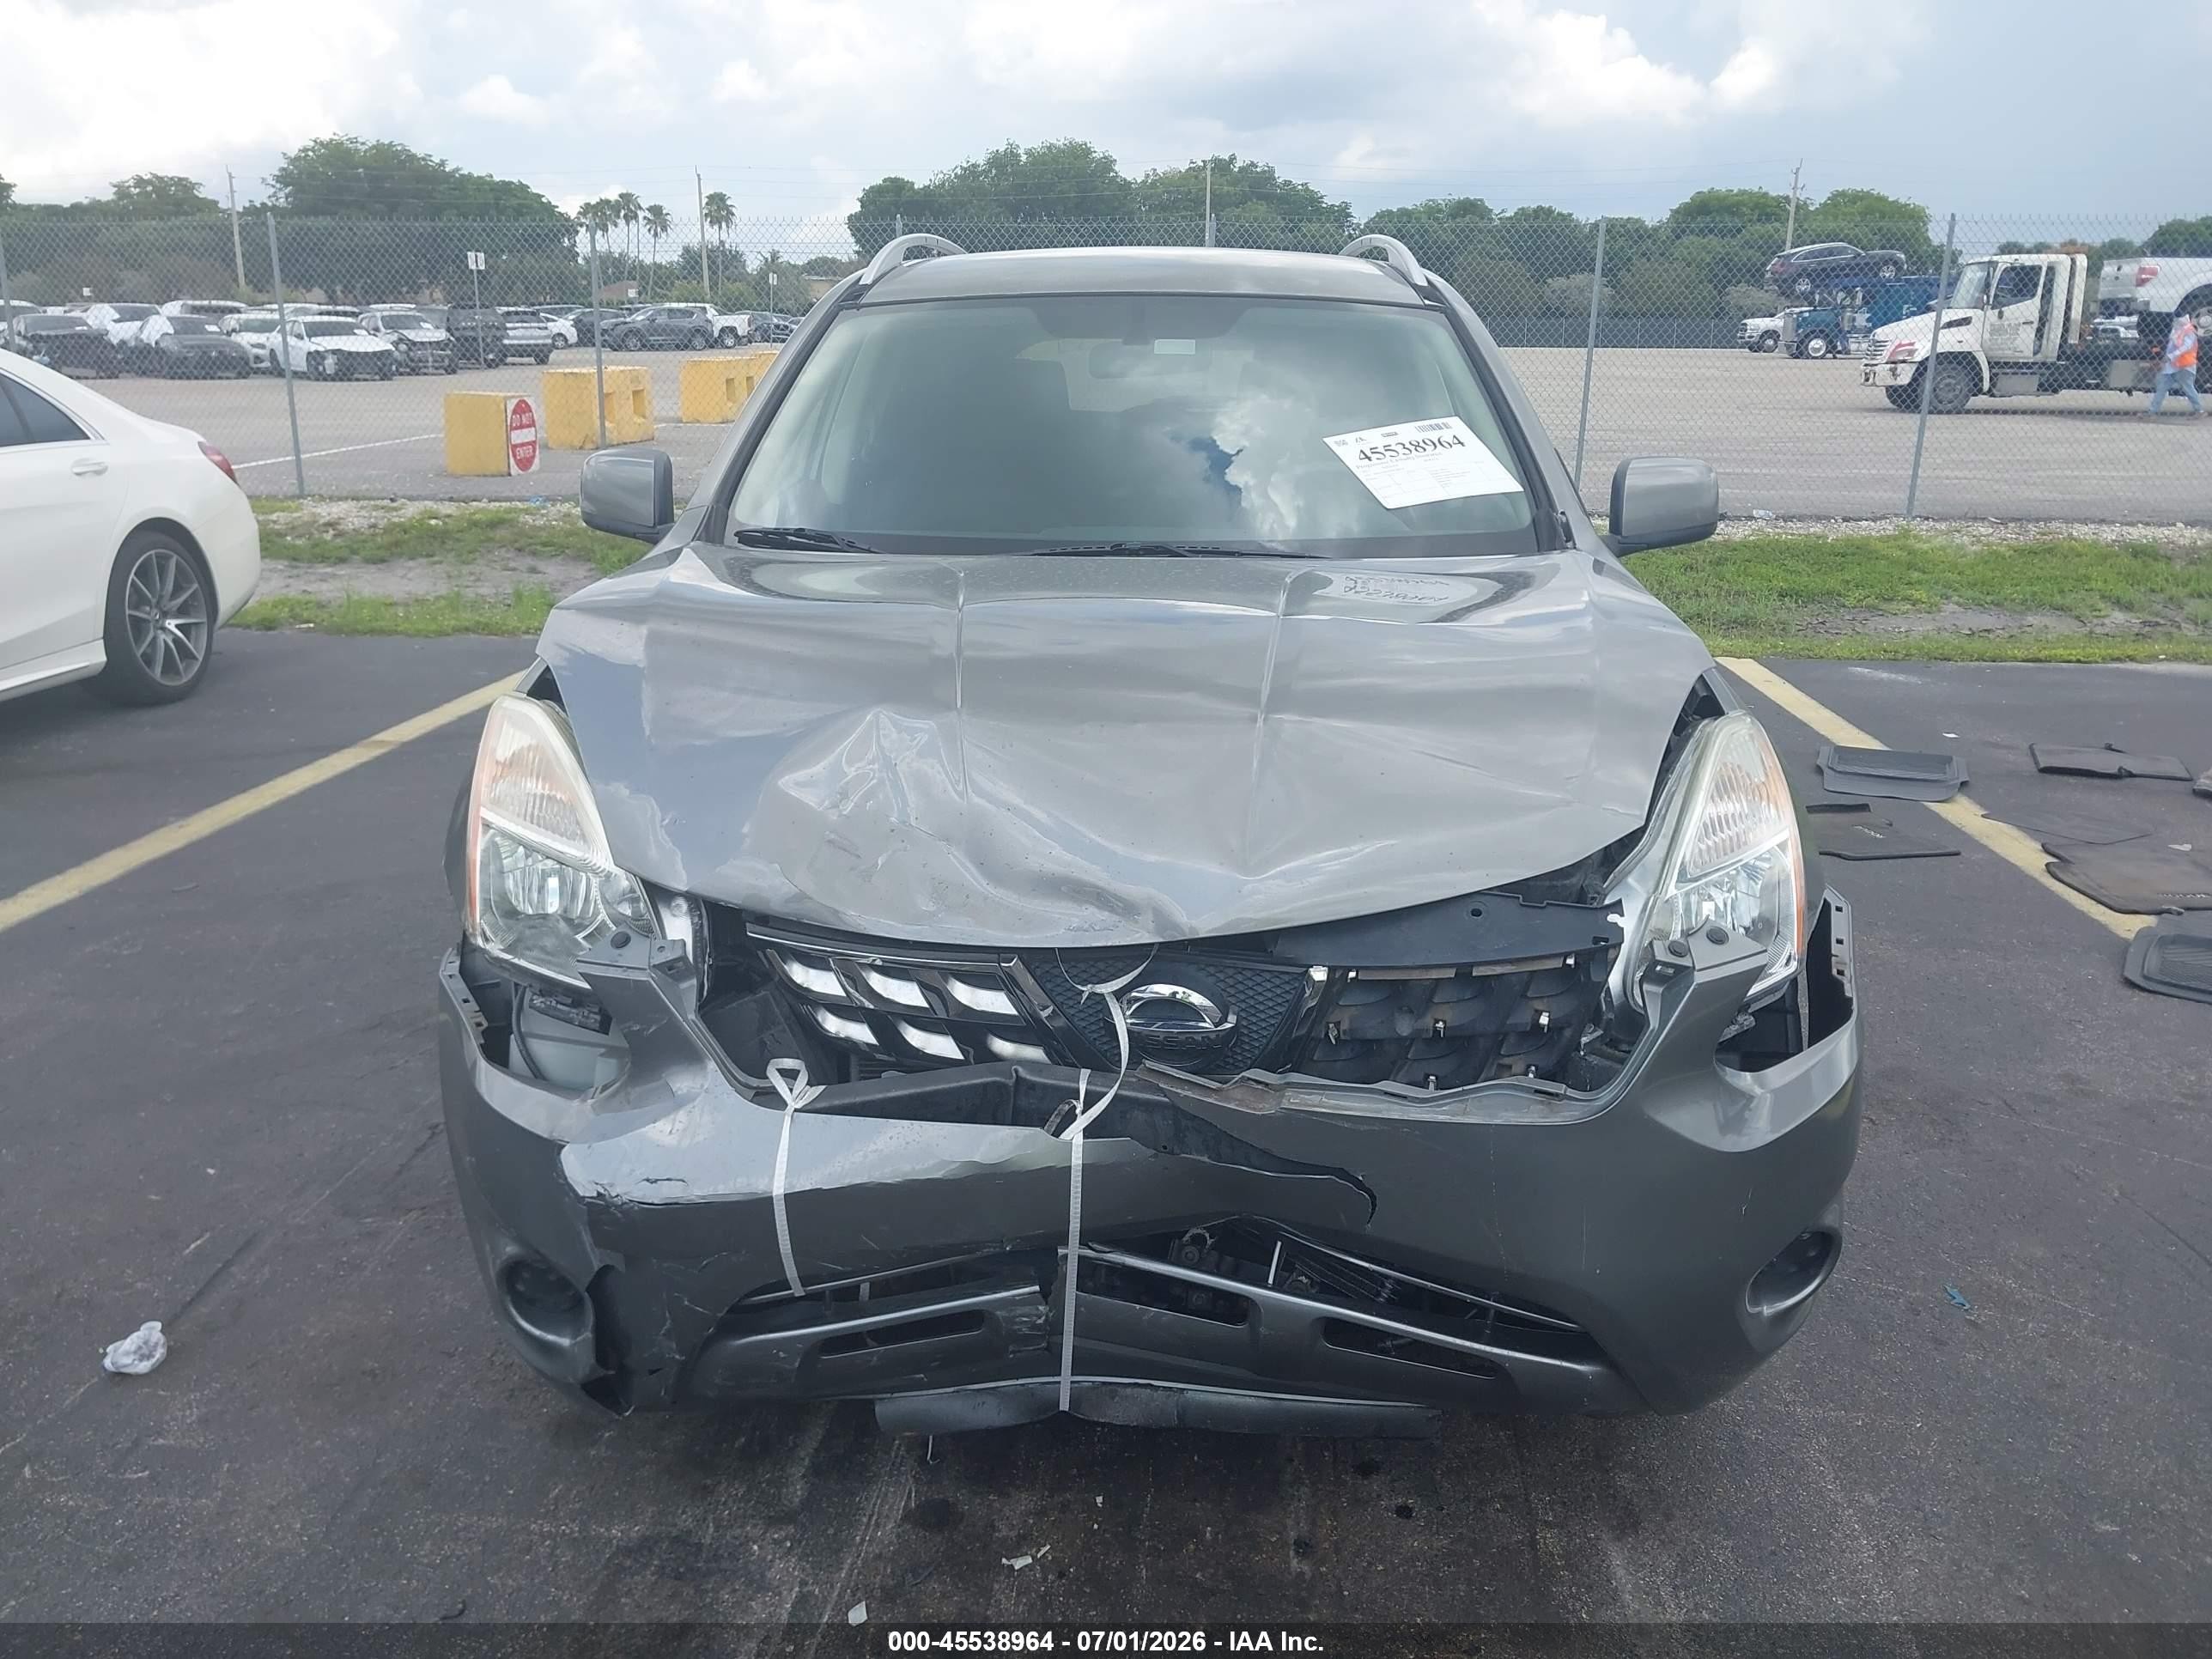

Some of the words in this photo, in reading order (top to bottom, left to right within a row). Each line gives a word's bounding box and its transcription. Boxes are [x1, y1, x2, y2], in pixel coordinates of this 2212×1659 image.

[512, 414, 521, 427] DO
[521, 411, 533, 425] NOT
[516, 445, 533, 459] ENTER
[1358, 434, 1467, 462] 45538964
